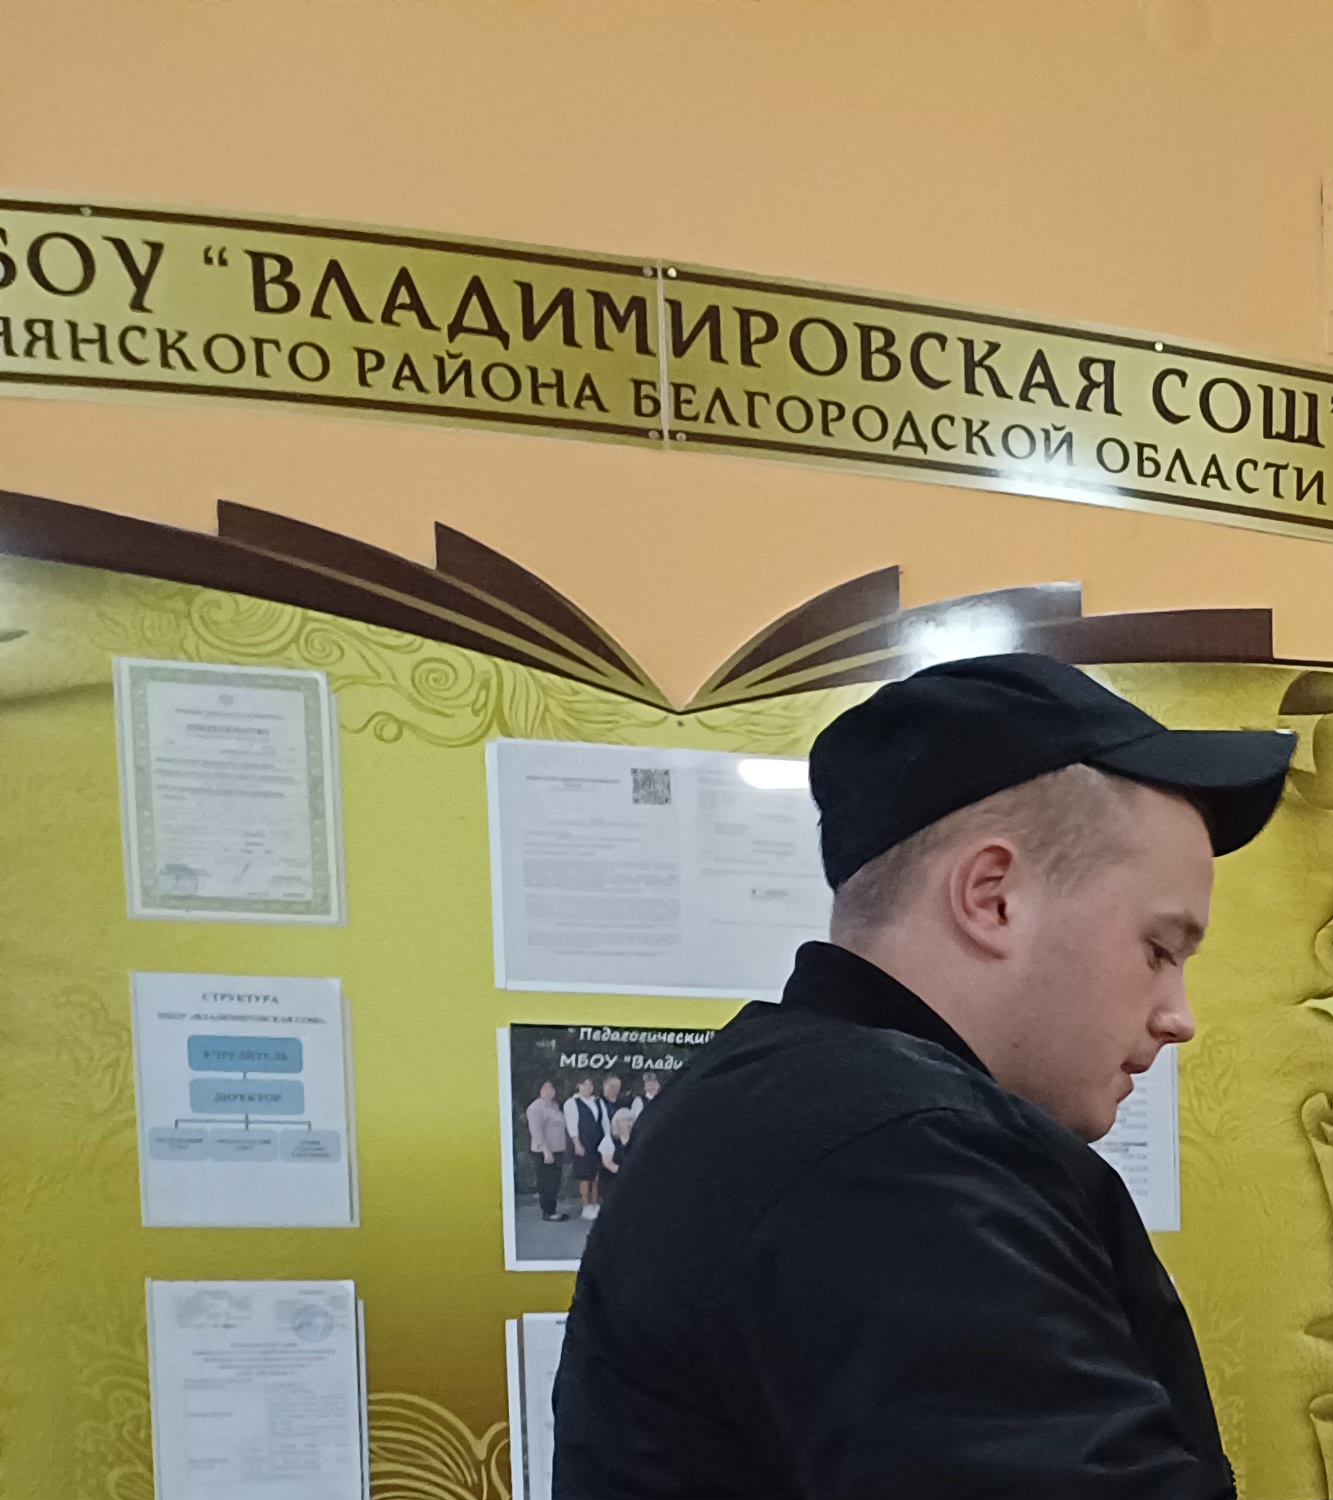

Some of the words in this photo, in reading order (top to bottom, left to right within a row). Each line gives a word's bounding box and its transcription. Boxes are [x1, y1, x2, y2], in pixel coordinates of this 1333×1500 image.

[352, 346, 610, 413] РАЙОНА
[630, 377, 1075, 467] БЕЛГОРОДСКОЙ
[1096, 437, 1327, 505] ОБЛАСТИ
[559, 1052, 618, 1070] МБОУ
[623, 1054, 684, 1071] "Влади
